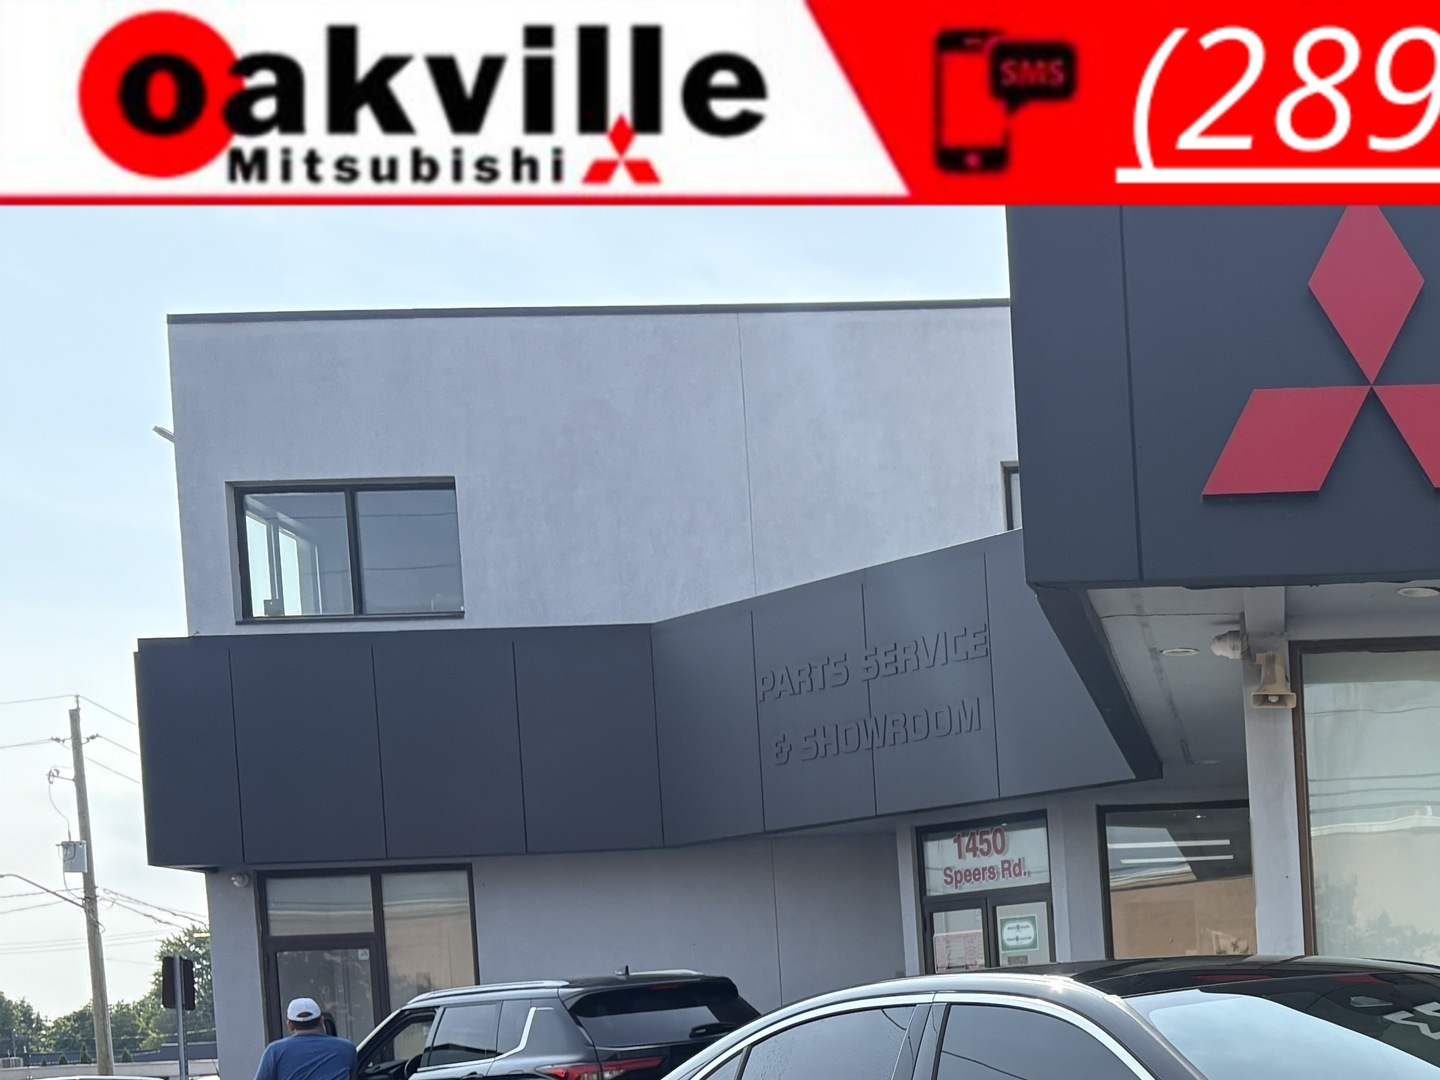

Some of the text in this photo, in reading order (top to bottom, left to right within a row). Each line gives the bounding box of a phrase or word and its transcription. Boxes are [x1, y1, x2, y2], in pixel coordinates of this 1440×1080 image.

[758, 623, 989, 703] PARTS SERVICE
[774, 697, 982, 766] & SHOWROOM
[953, 827, 1007, 859] 1450
[943, 863, 997, 889] Speers
